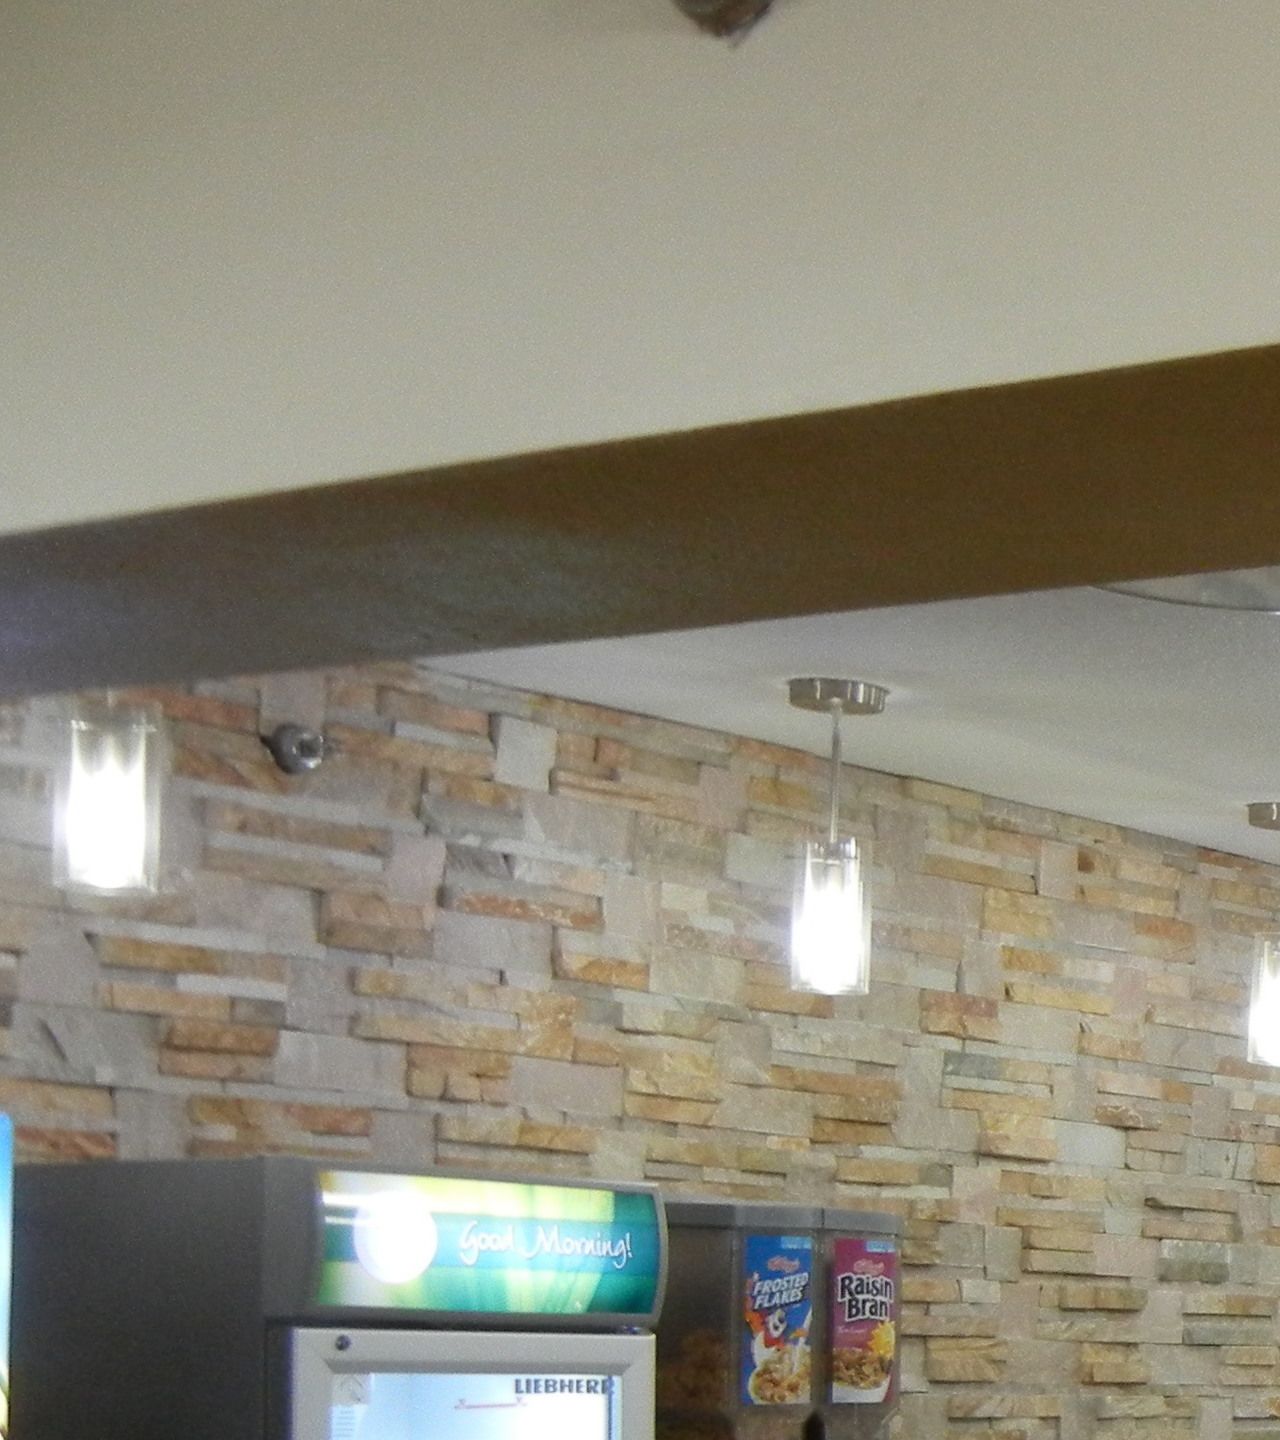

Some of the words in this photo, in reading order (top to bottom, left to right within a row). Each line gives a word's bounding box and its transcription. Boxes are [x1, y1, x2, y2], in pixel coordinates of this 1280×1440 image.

[460, 1220, 514, 1265] Good
[522, 1224, 633, 1269] Morning!
[752, 1272, 809, 1297] FROSTED
[838, 1272, 895, 1303] Raisin
[753, 1287, 804, 1310] FLAKES
[846, 1299, 890, 1322] Bran
[514, 1378, 615, 1395] LIEBHERR
